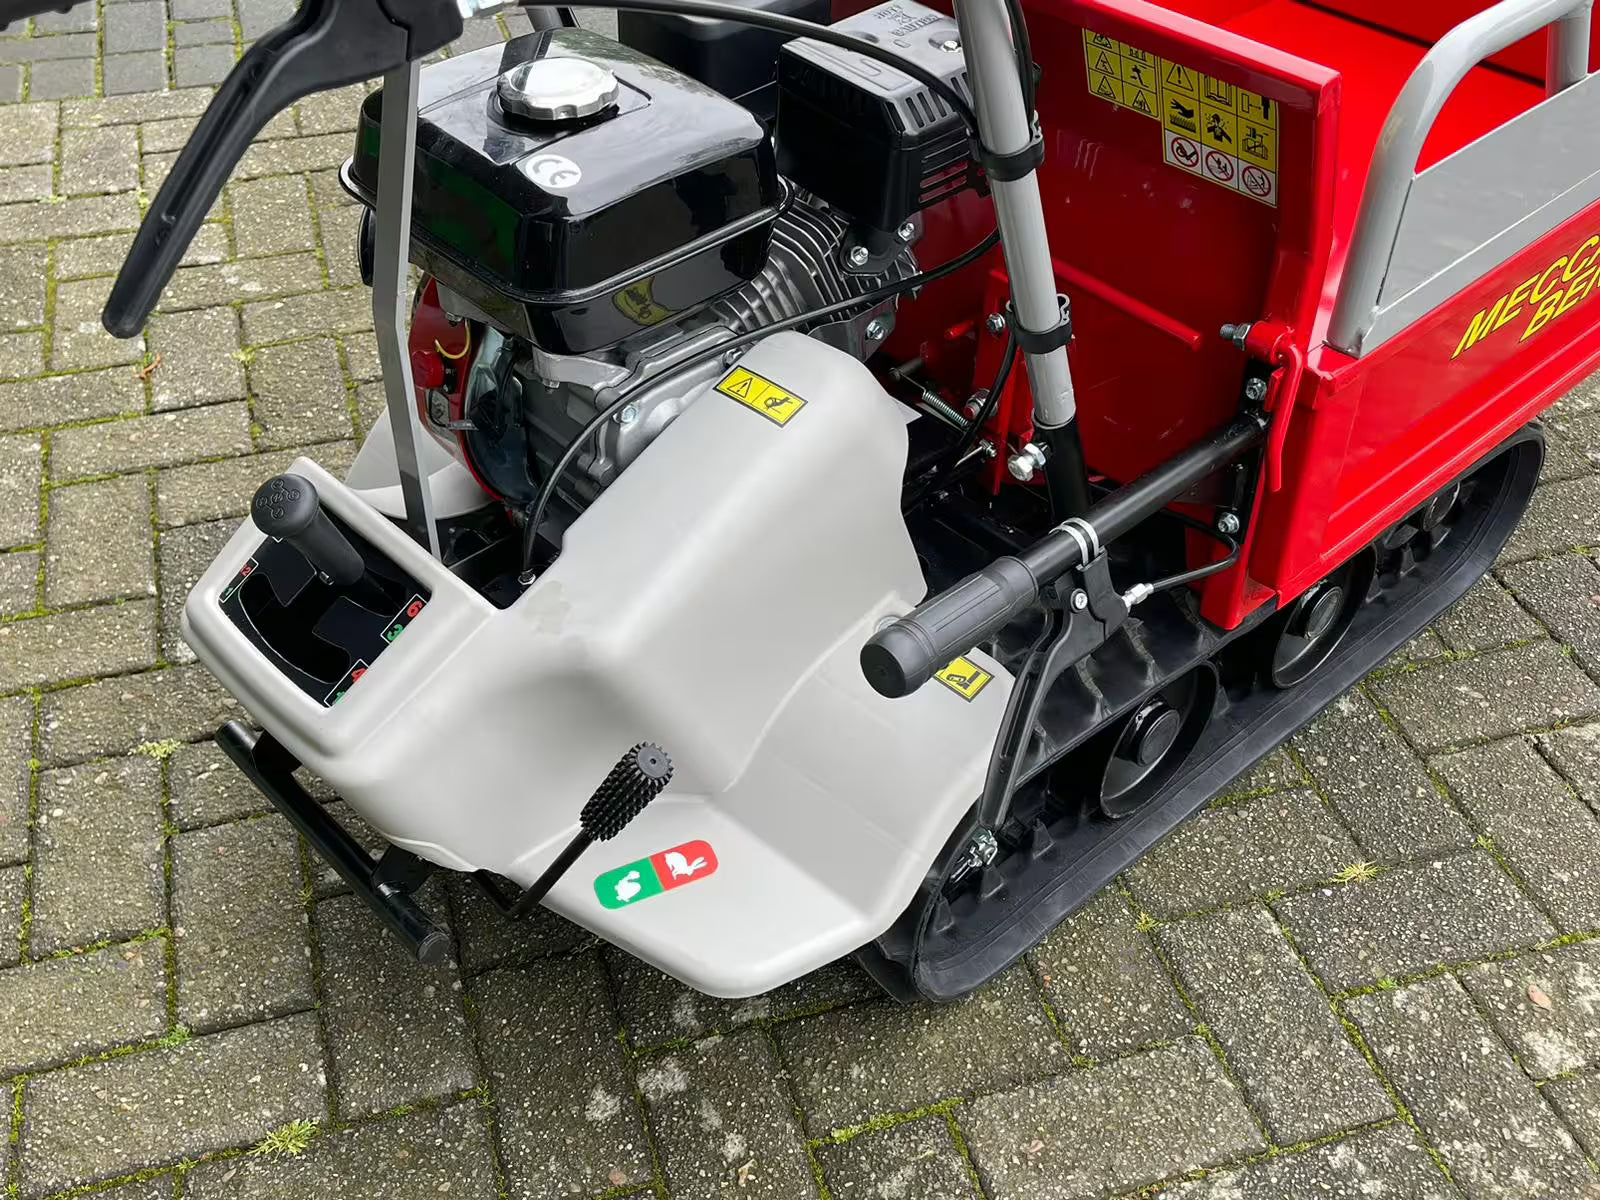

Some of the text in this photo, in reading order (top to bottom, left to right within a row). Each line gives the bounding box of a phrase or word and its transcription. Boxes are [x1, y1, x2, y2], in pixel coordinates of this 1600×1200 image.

[532, 158, 580, 186] CE
[1450, 234, 1600, 361] MECC
[407, 600, 423, 618] 6
[387, 623, 404, 641] 3
